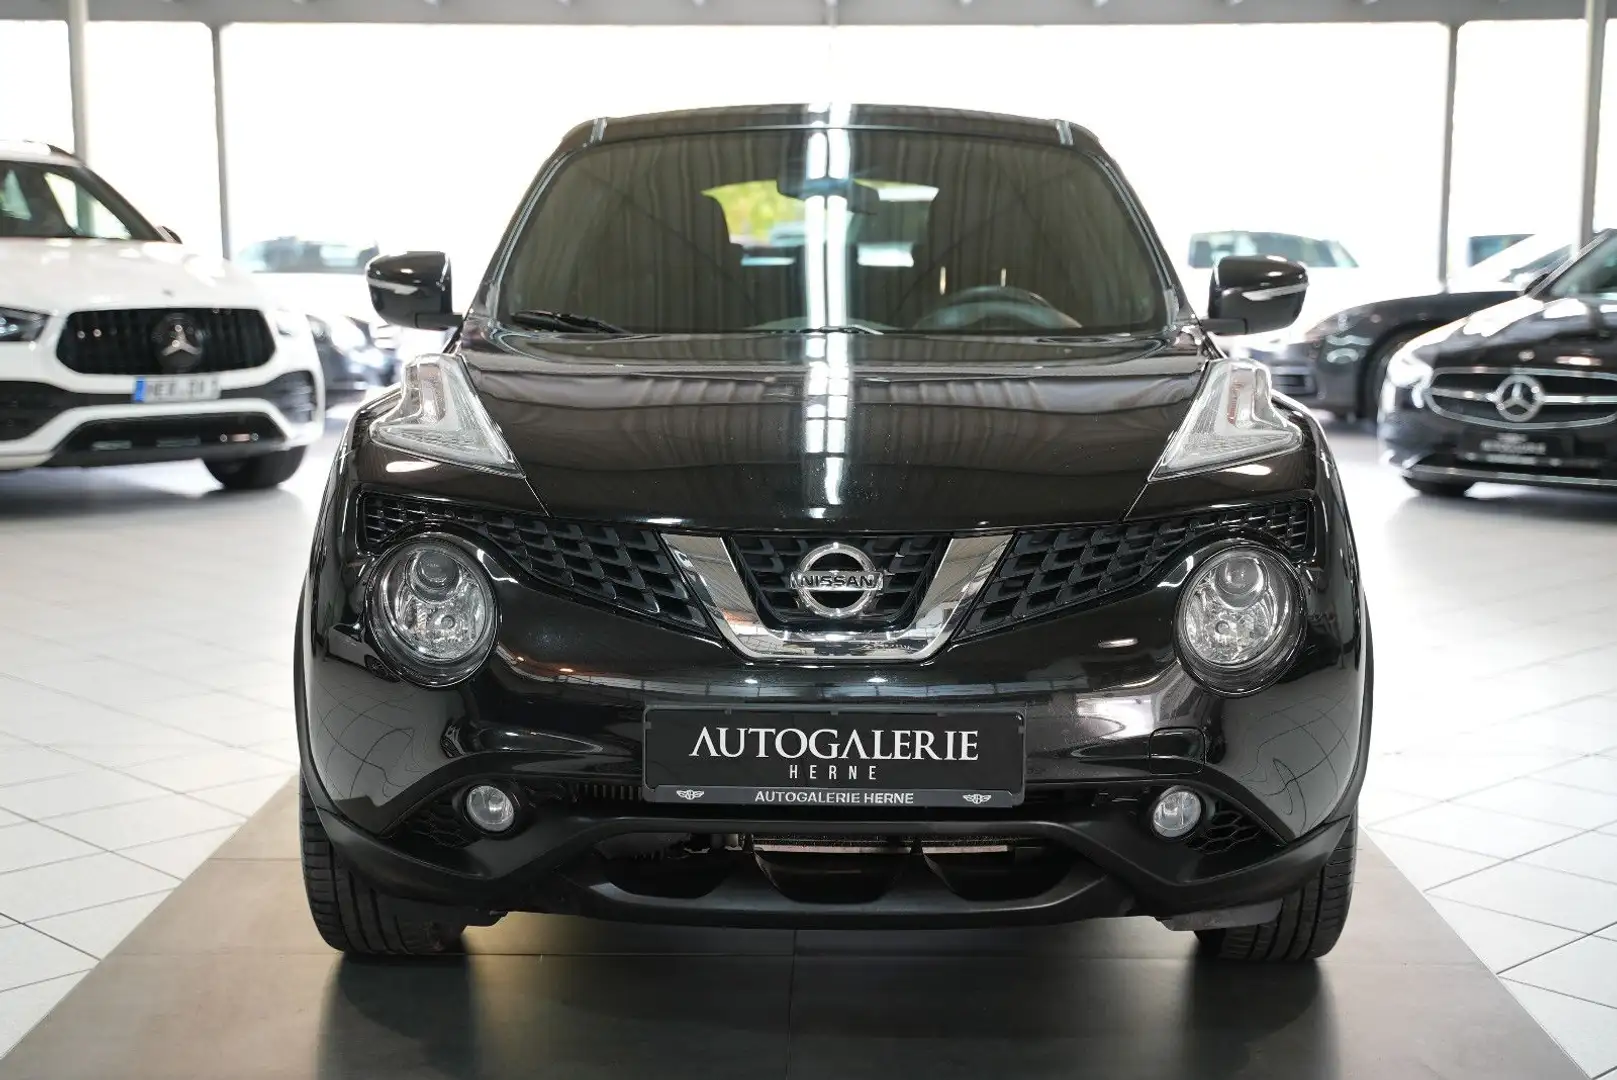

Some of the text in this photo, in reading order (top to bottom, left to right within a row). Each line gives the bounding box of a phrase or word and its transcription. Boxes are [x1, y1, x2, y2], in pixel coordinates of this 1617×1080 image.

[800, 575, 873, 587] NISSAN
[689, 727, 978, 761] AUTOGALERIE
[789, 764, 877, 780] HERNE
[754, 790, 914, 804] AUTOGALERIE HERNE
